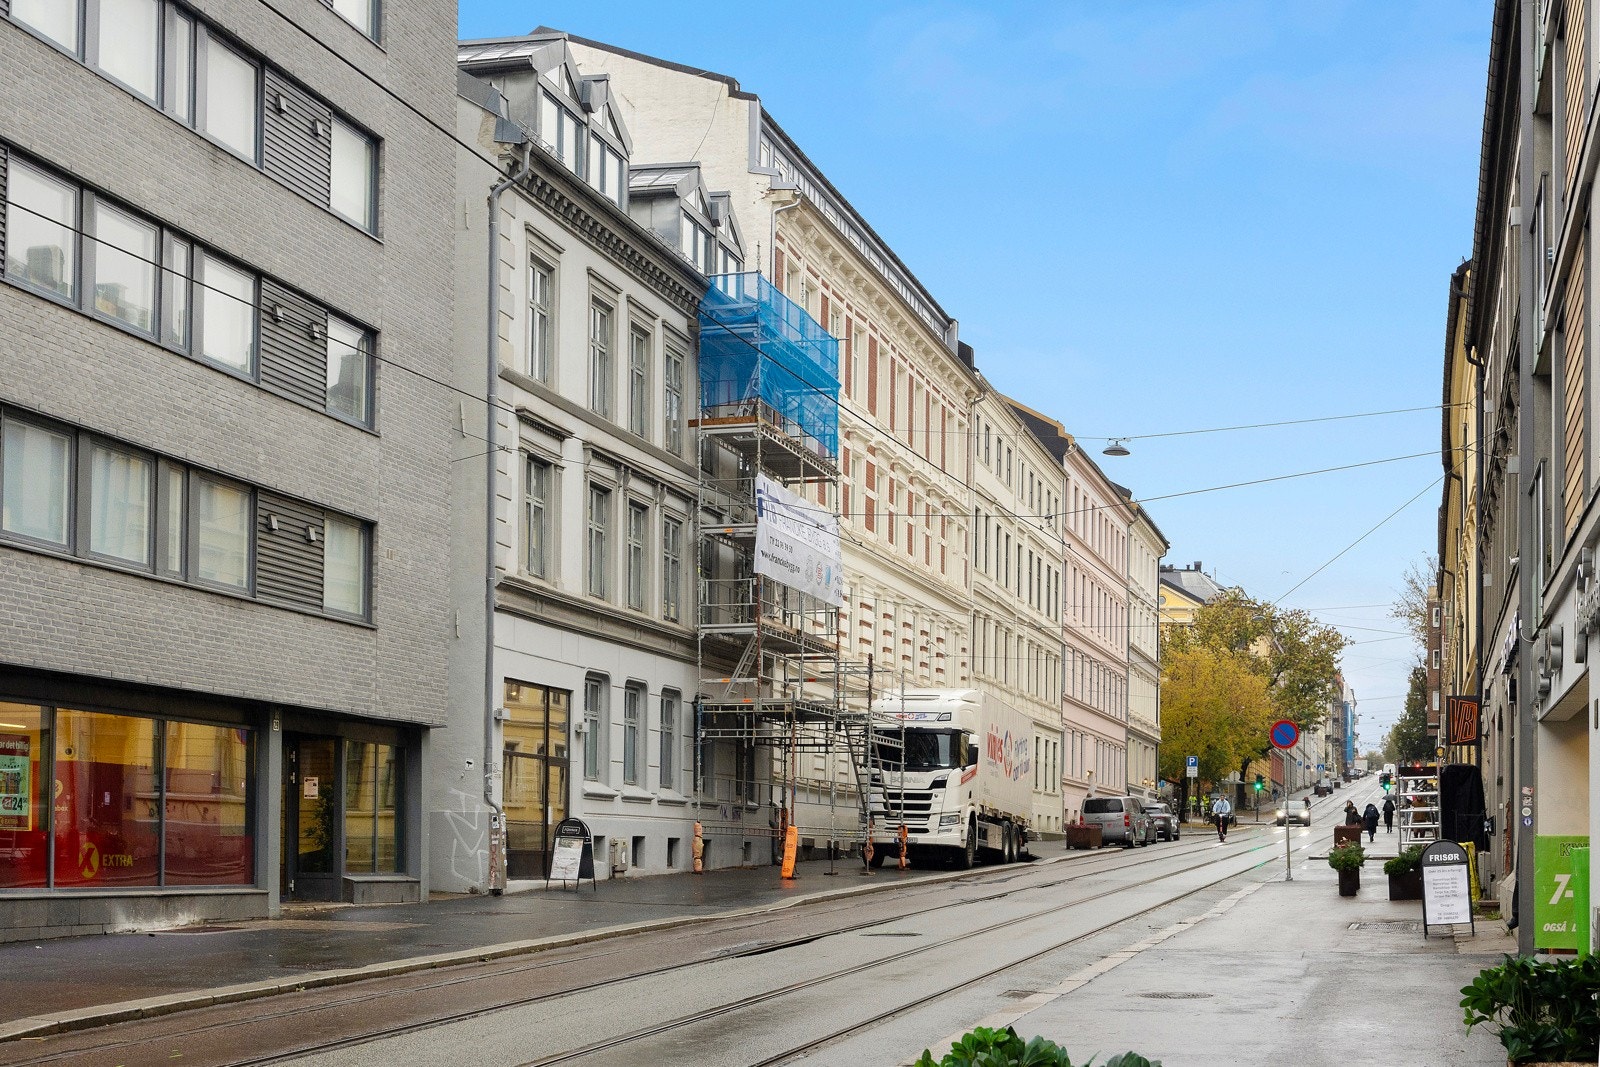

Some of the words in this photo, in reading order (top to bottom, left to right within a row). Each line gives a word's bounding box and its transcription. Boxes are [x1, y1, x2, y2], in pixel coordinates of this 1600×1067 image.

[1189, 757, 1196, 766] P
[102, 854, 134, 867] EXTRA
[1429, 853, 1460, 862] FRISØR
[1543, 920, 1567, 932] OGSÅ
